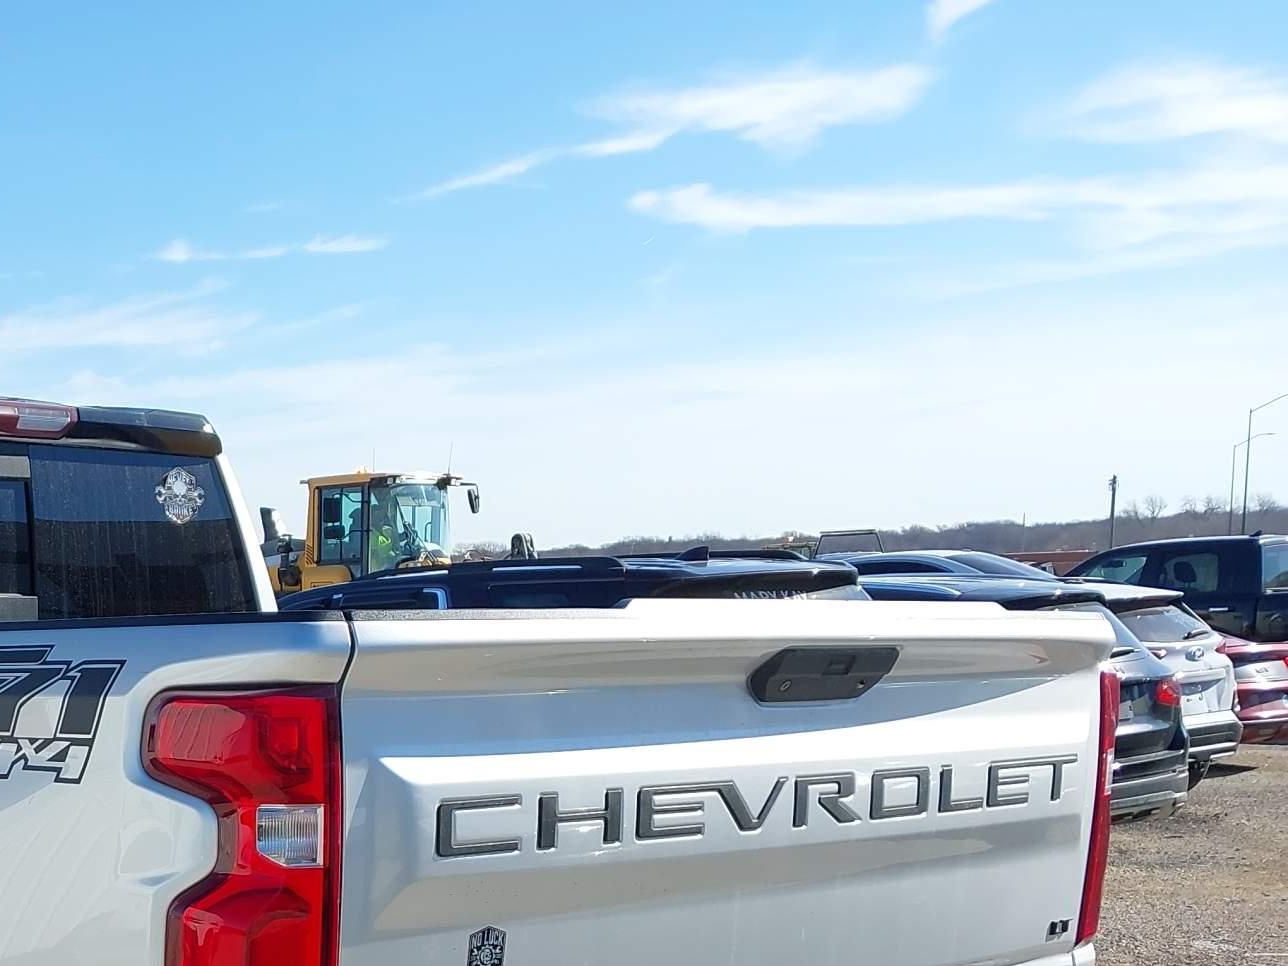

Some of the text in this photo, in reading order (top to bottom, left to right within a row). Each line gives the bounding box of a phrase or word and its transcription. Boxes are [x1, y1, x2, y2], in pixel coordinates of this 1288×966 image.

[434, 753, 1080, 859] CHEVROLET
[1047, 918, 1074, 936] LT
[471, 929, 504, 948] NO LUCK
